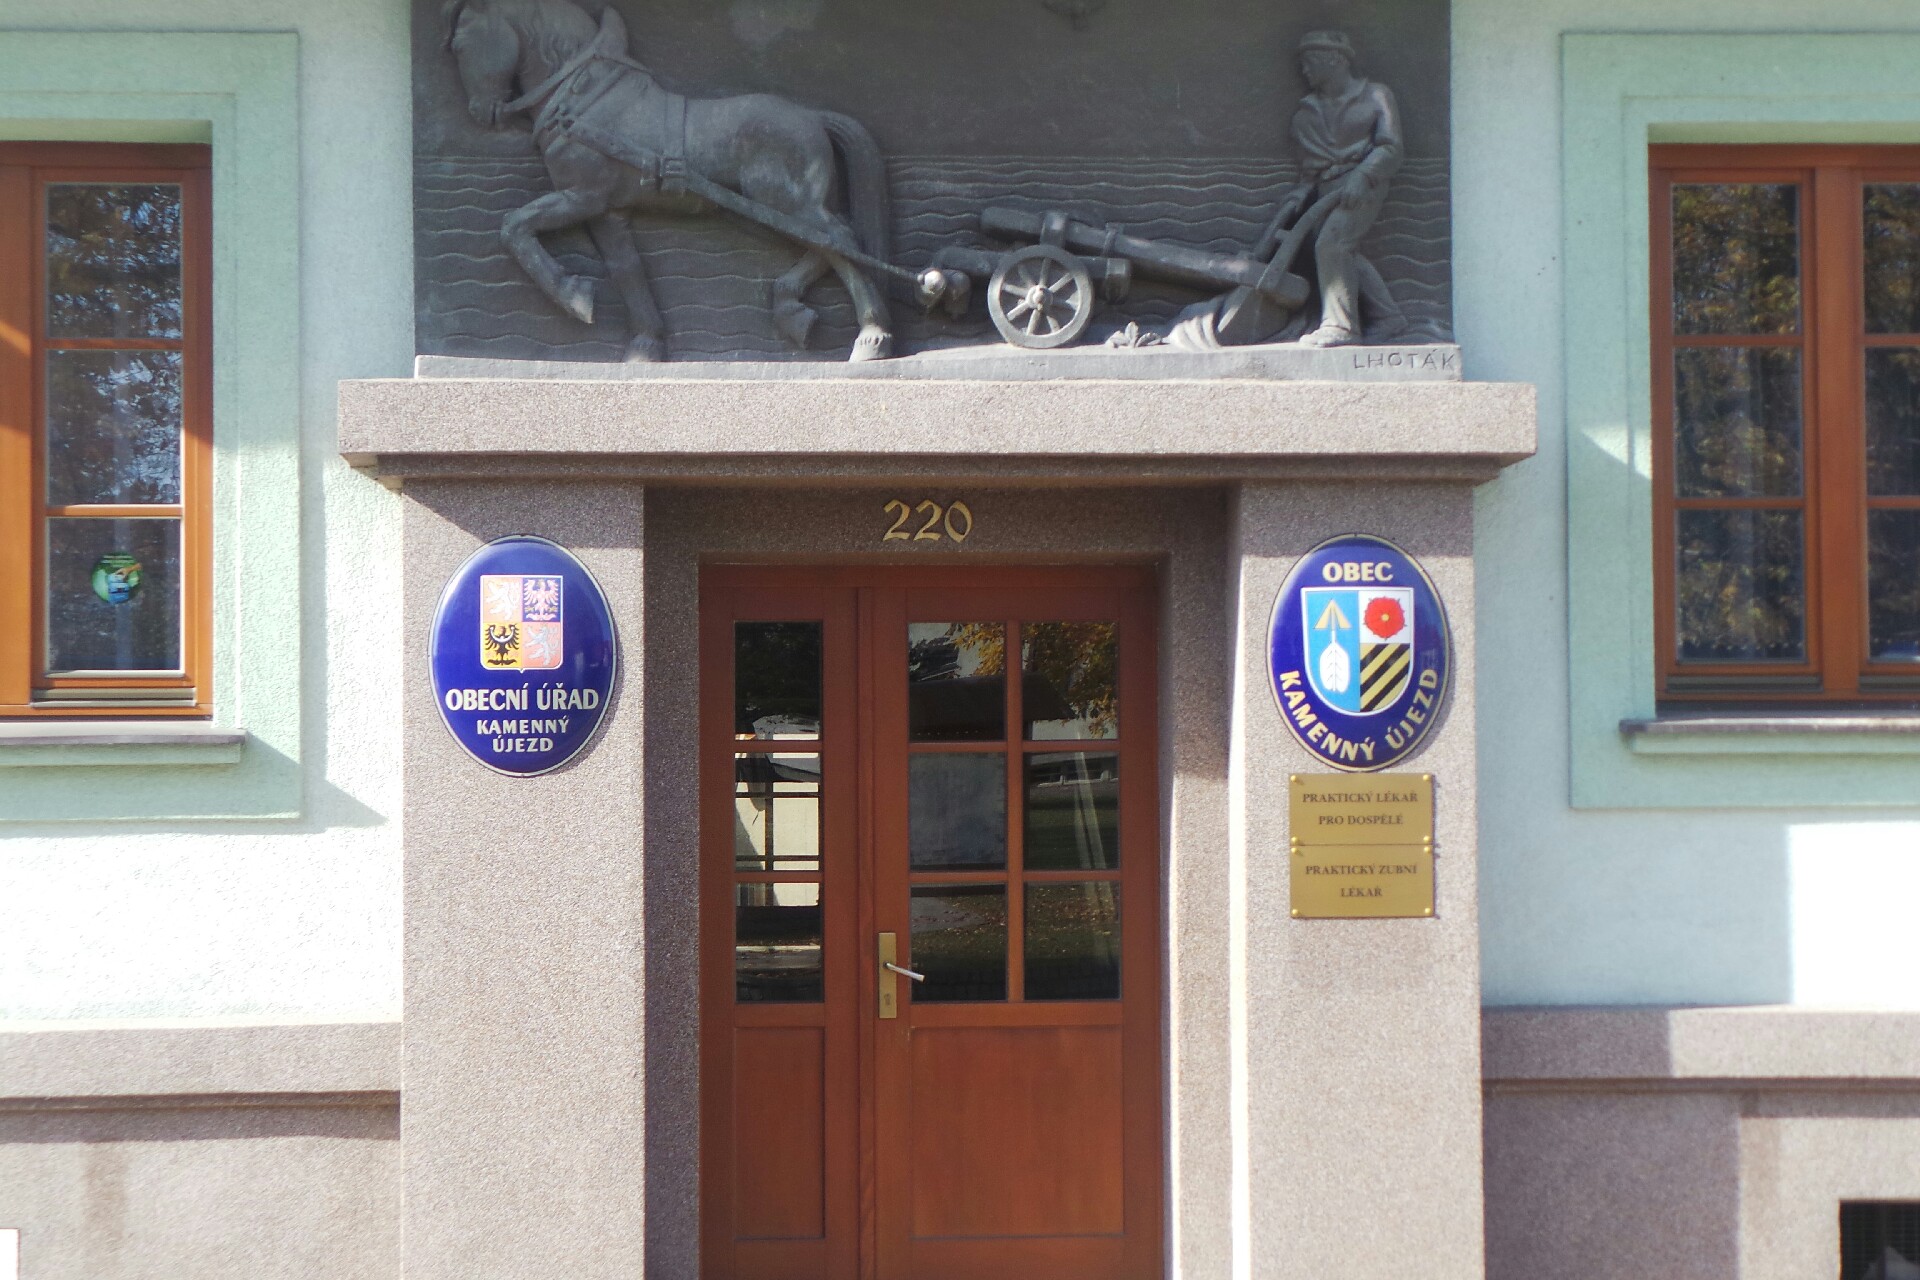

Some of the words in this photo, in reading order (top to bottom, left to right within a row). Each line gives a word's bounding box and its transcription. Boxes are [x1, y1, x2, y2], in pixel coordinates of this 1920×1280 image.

[1353, 348, 1455, 370] LHOTÁK
[882, 499, 972, 543] 220
[1322, 561, 1393, 582] OBEC
[445, 683, 528, 711] OBECNÍ
[537, 683, 599, 711] ÚŘAD
[477, 715, 570, 735] KAMENNÝ
[1280, 670, 1376, 761] KAMENNÝ
[1385, 669, 1438, 749] ÚJEZD
[492, 735, 554, 752] ÚJEZD
[1302, 791, 1374, 803] PRAKTICKÝ
[1318, 815, 1344, 825] PRO
[1305, 863, 1375, 875] PRAKTICKÝ
